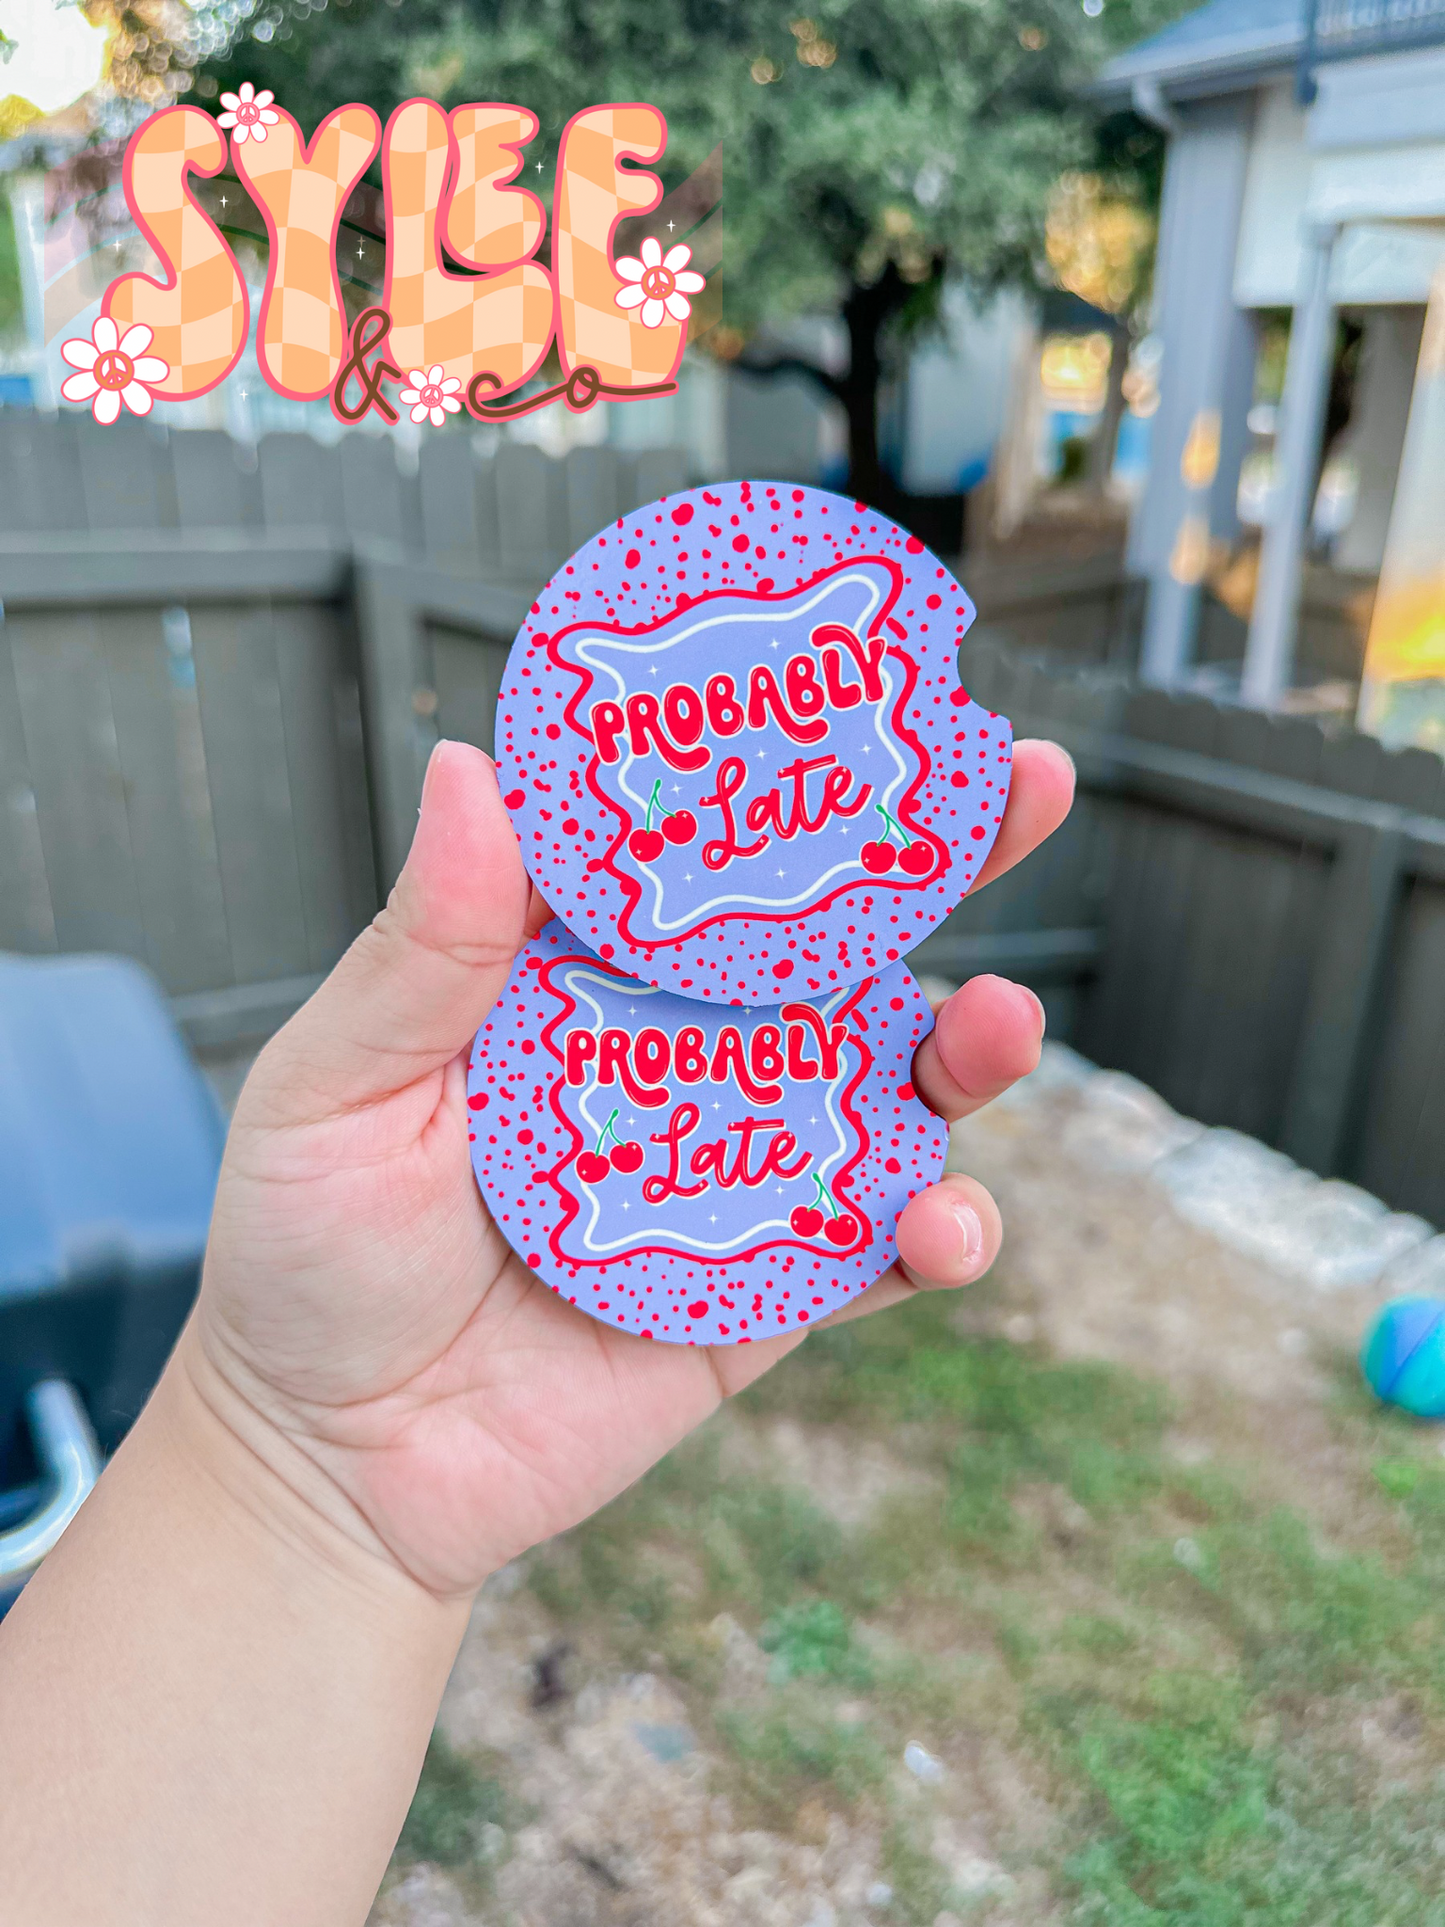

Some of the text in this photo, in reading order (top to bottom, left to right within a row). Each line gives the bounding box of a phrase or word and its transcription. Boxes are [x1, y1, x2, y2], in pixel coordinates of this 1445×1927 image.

[591, 624, 886, 771] PROBABLY
[699, 754, 874, 871] Late
[565, 1004, 848, 1107] PROBABLY
[642, 1102, 813, 1204] Late
